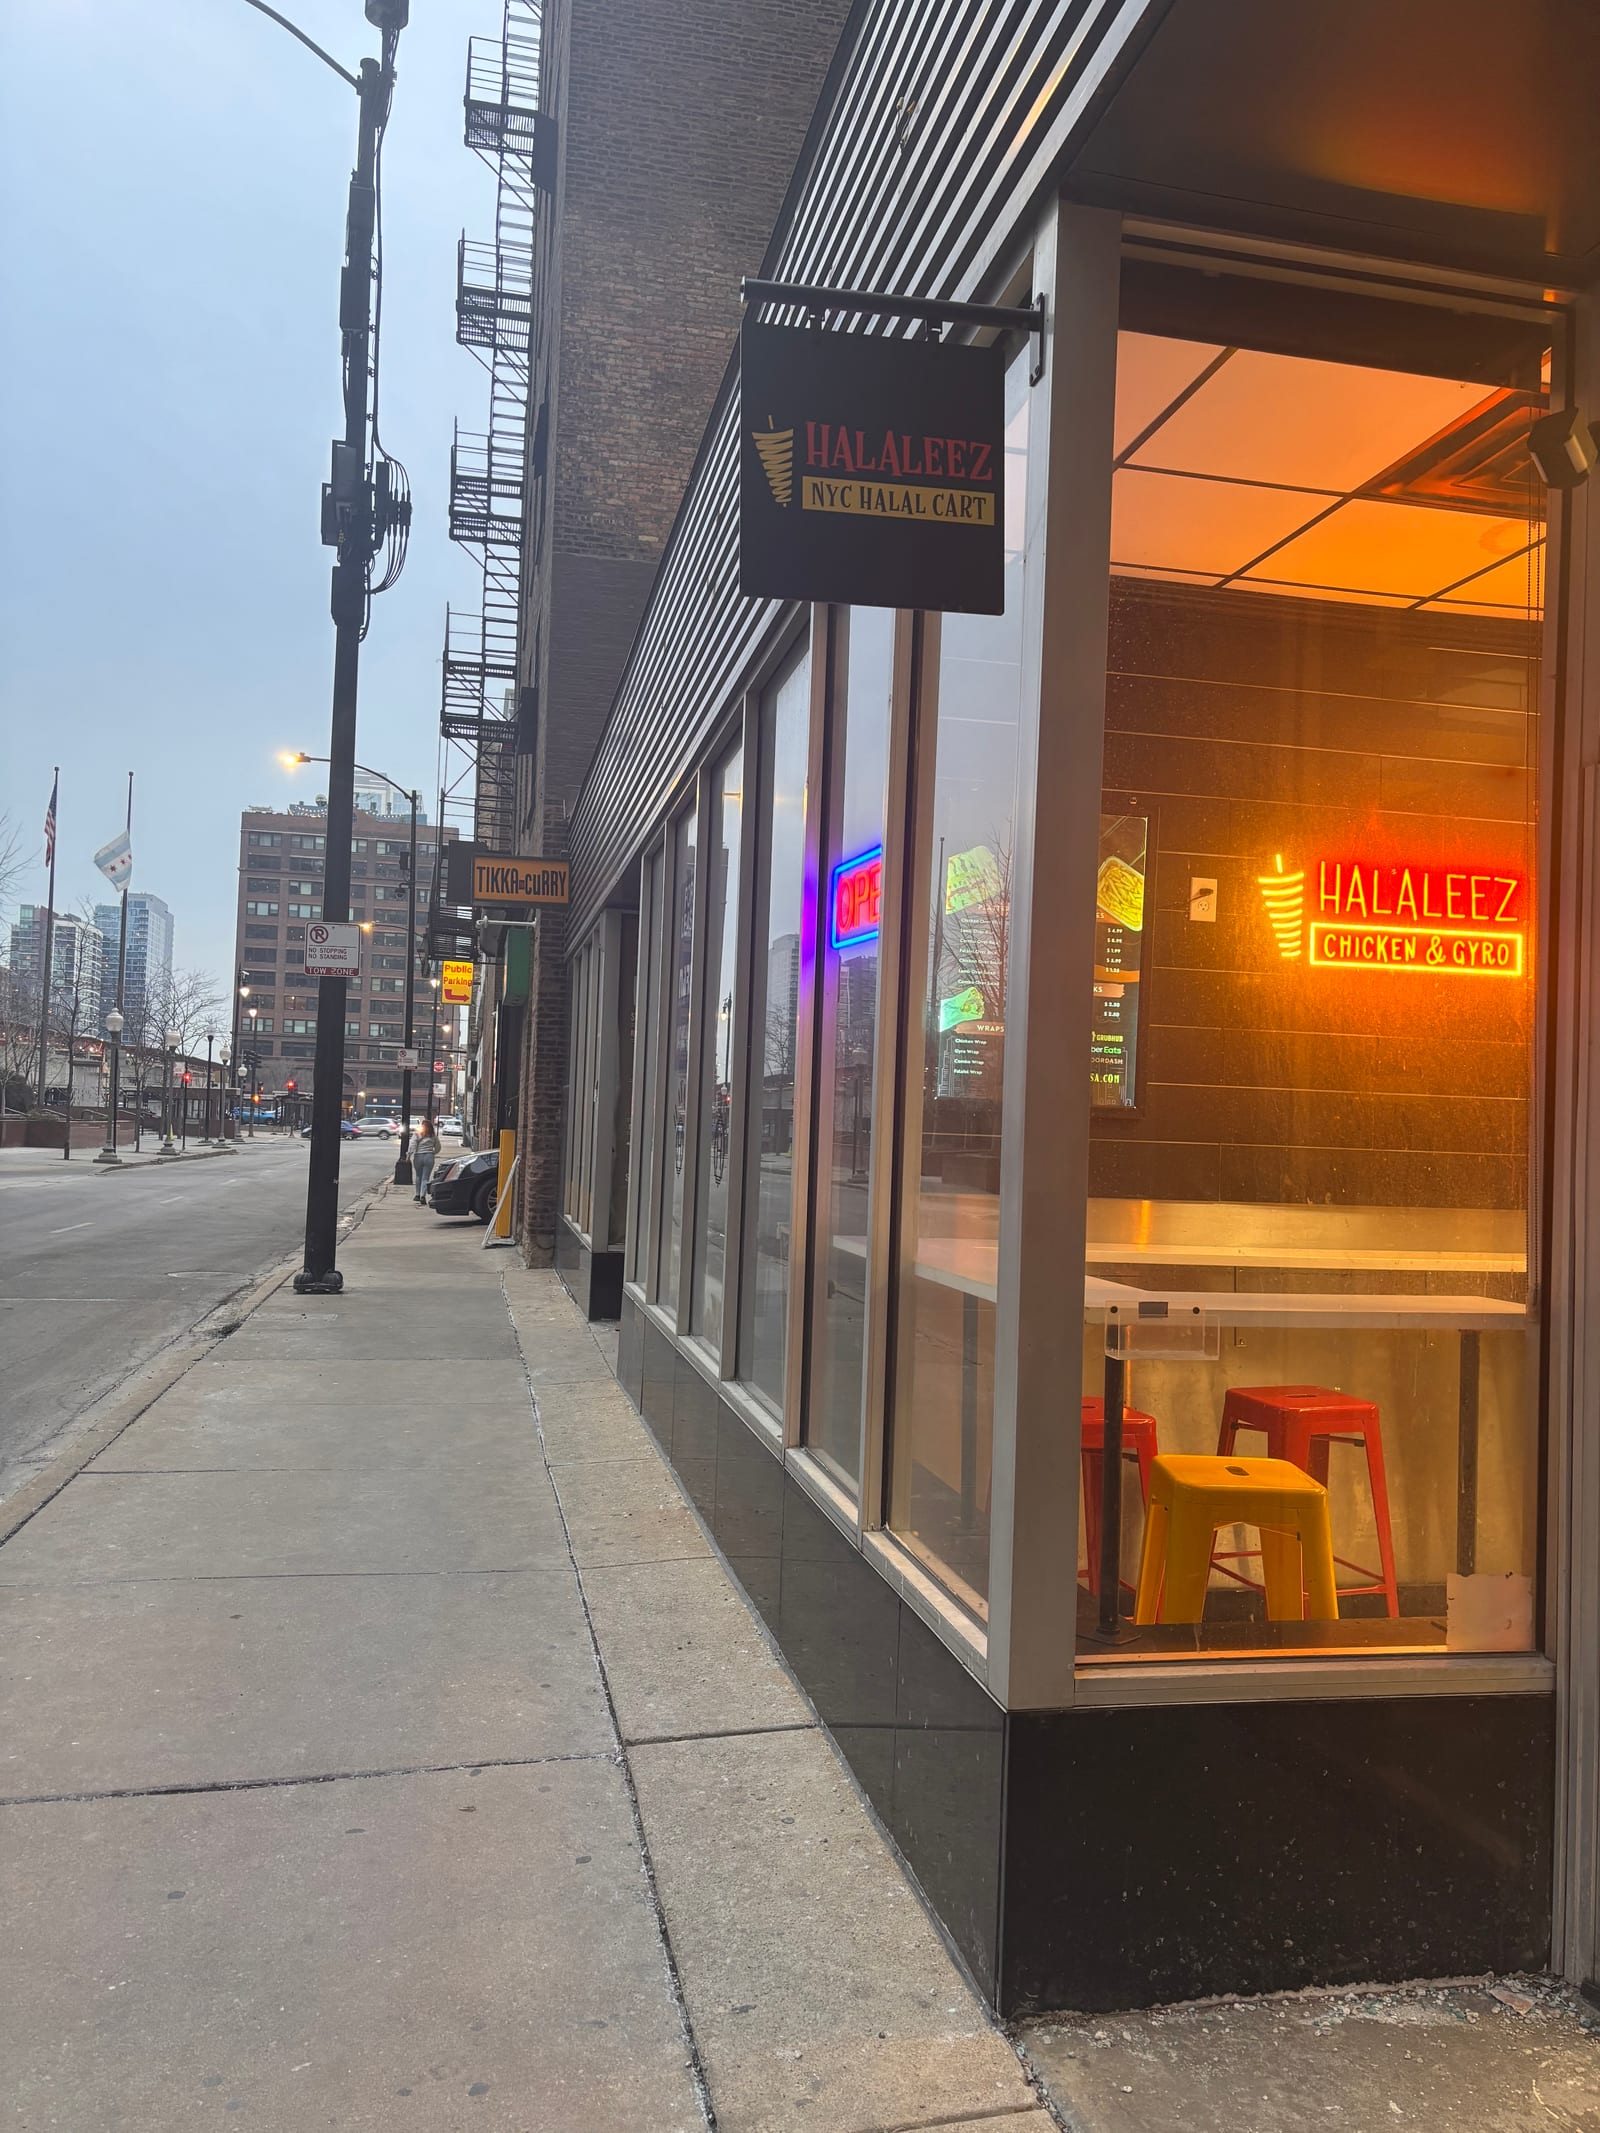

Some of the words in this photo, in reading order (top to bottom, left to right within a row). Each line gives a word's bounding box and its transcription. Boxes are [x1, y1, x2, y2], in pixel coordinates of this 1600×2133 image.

[805, 420, 993, 481] HALALEEZ
[811, 481, 852, 508] NYC
[859, 486, 926, 515] HALAL
[932, 493, 986, 520] CART
[476, 866, 519, 894] TIKKA
[1319, 861, 1518, 922] HALALEEZ
[1323, 933, 1416, 963] CHICKEN
[1425, 935, 1447, 965] &
[1452, 940, 1510, 966] GYRO
[443, 977, 472, 987] Parking
[444, 964, 472, 973] Public
[976, 1024, 1005, 1033] WRAPS
